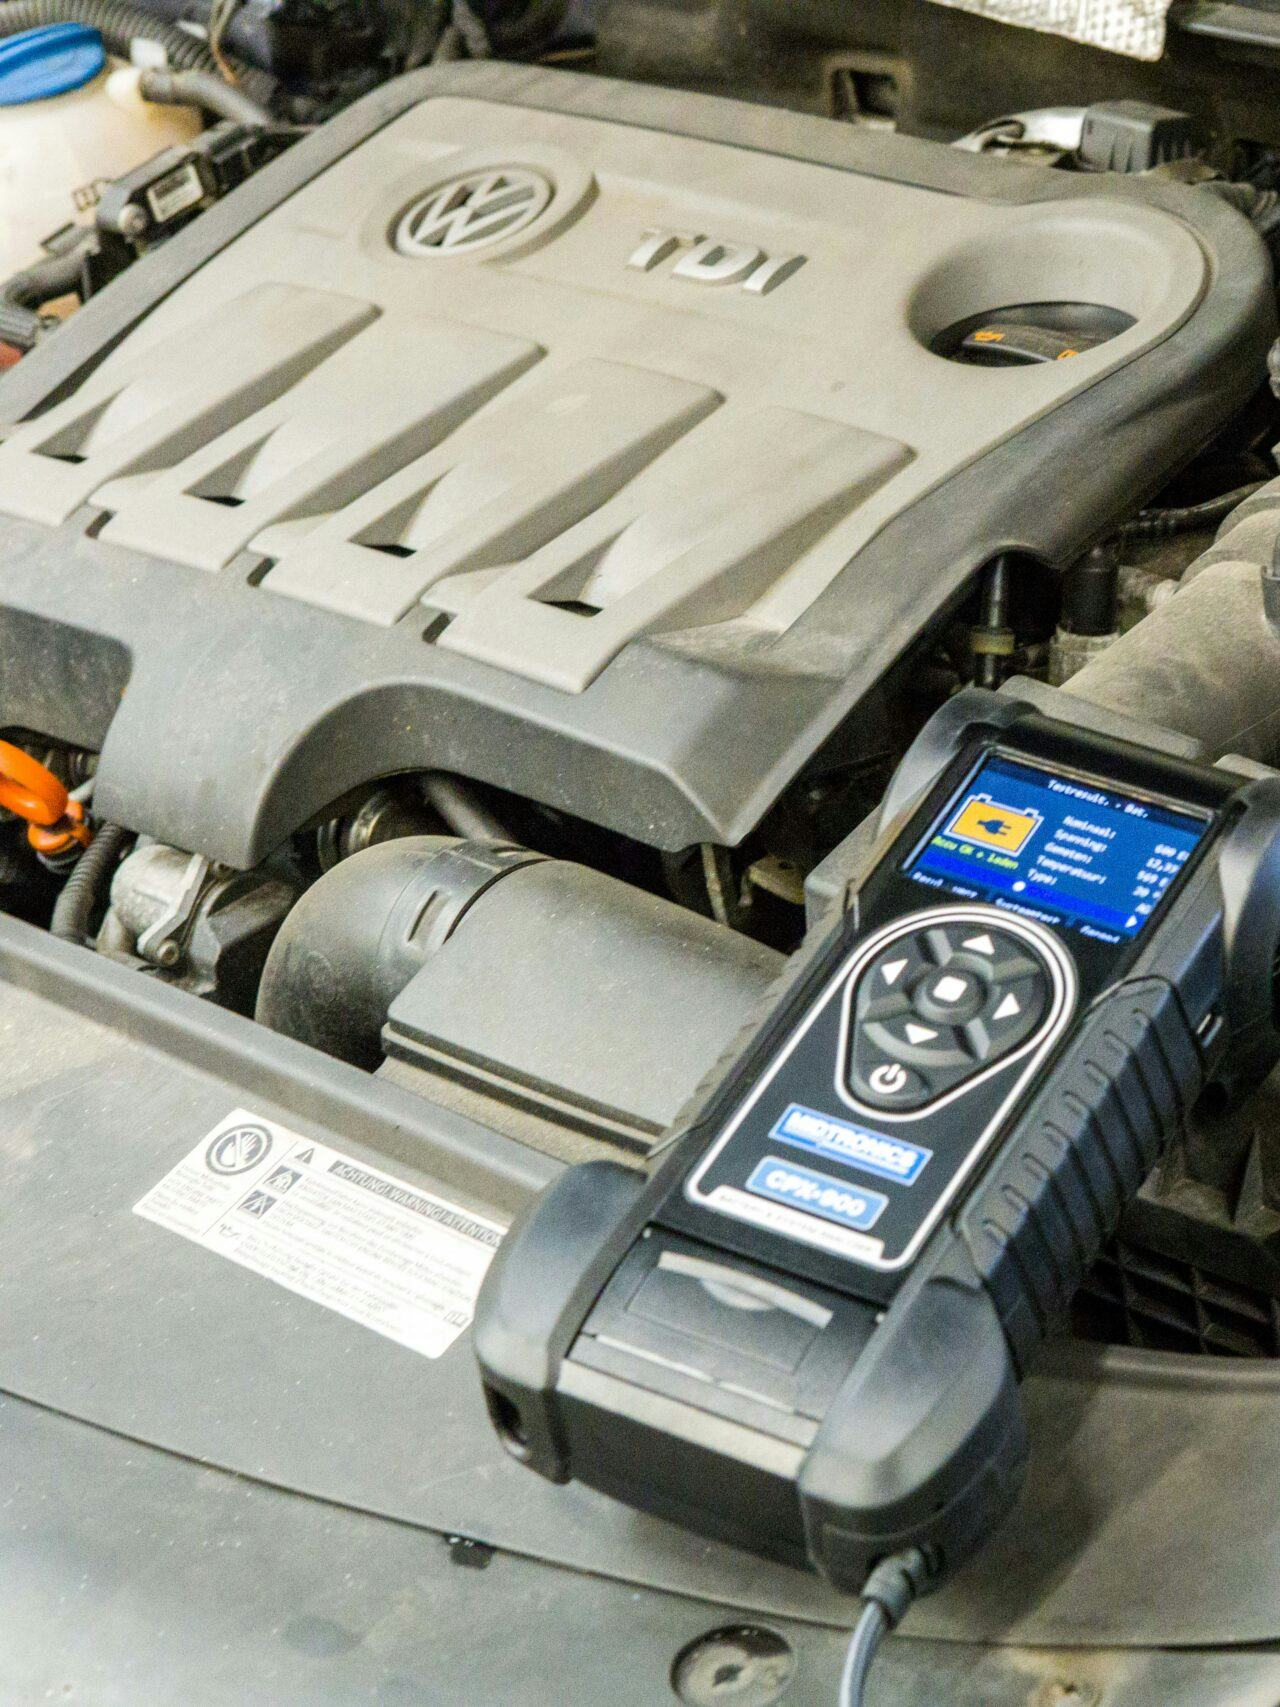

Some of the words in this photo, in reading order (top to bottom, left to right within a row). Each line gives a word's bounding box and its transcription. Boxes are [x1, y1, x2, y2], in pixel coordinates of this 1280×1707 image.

[626, 227, 805, 296] TDI
[1027, 867, 1058, 886] Type:
[782, 1111, 920, 1168] MIDTRONICS
[333, 1163, 390, 1199] ACHTUNG!
[388, 1187, 447, 1222] WARNING!
